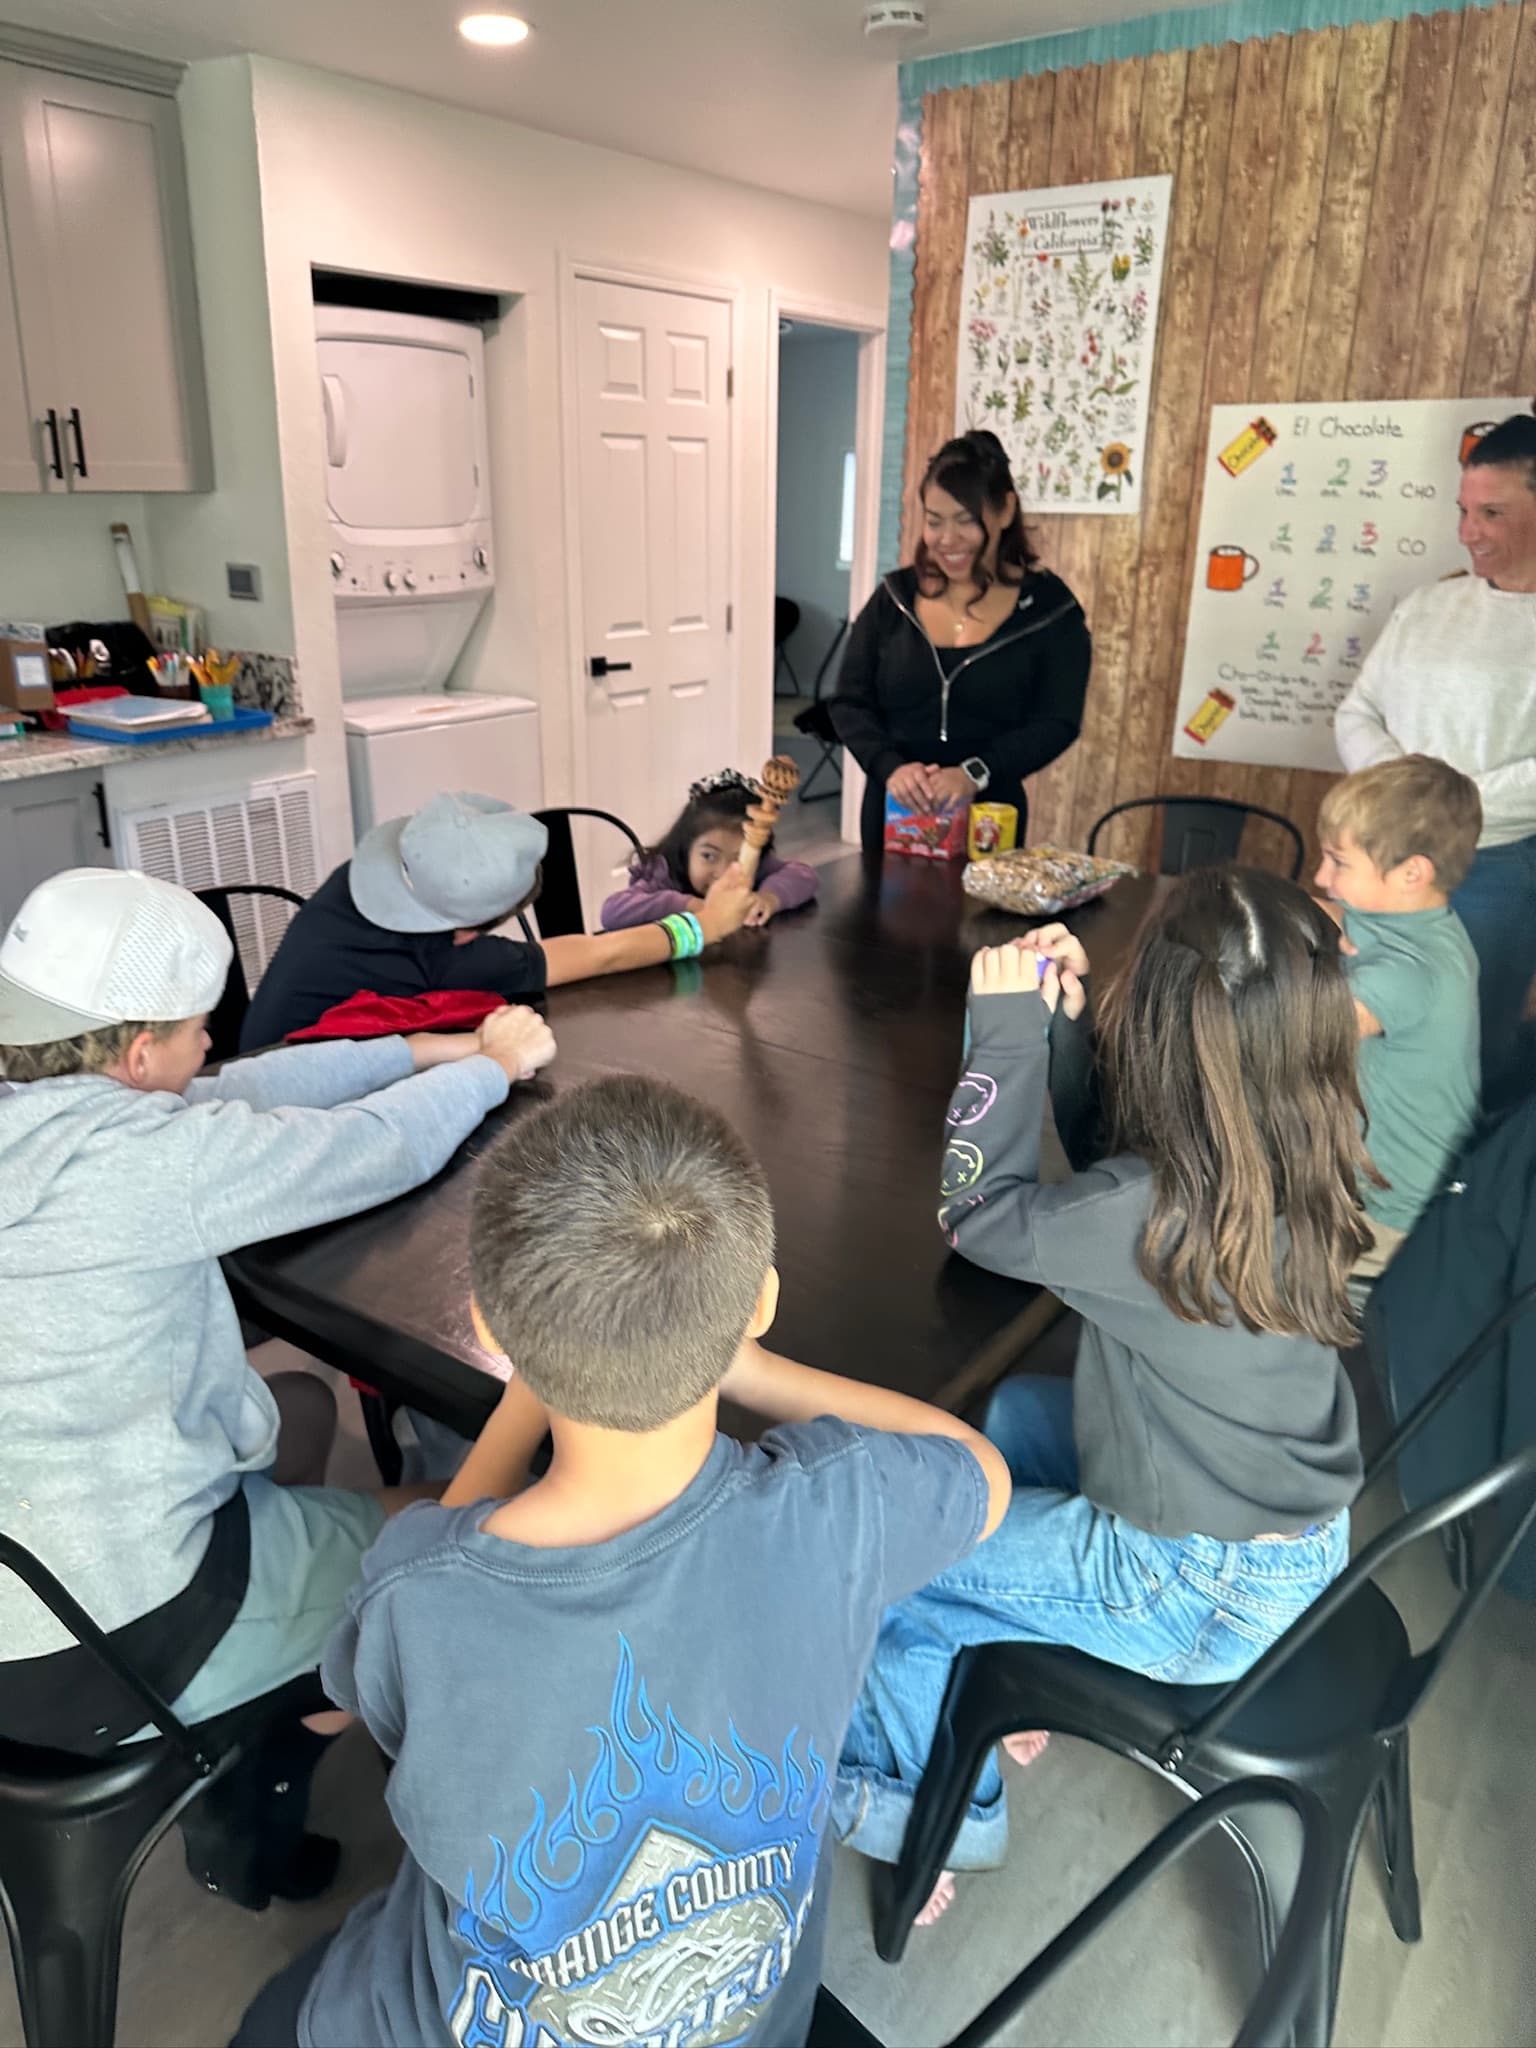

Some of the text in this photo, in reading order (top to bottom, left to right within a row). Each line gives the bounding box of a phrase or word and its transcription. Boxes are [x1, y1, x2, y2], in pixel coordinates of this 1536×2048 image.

[1026, 210, 1100, 230] Wildflowers
[1033, 230, 1098, 250] California
[1294, 415, 1404, 438] El Chocolate
[1280, 461, 1297, 486] 1
[1327, 457, 1350, 487] 2
[1366, 459, 1388, 487] 3
[1400, 482, 1437, 499] CHO
[1360, 521, 1379, 547] 3
[1397, 537, 1427, 556] CO
[1310, 577, 1333, 604] 2
[1305, 632, 1326, 656] 2
[666, 1841, 798, 1921] COUNTY
